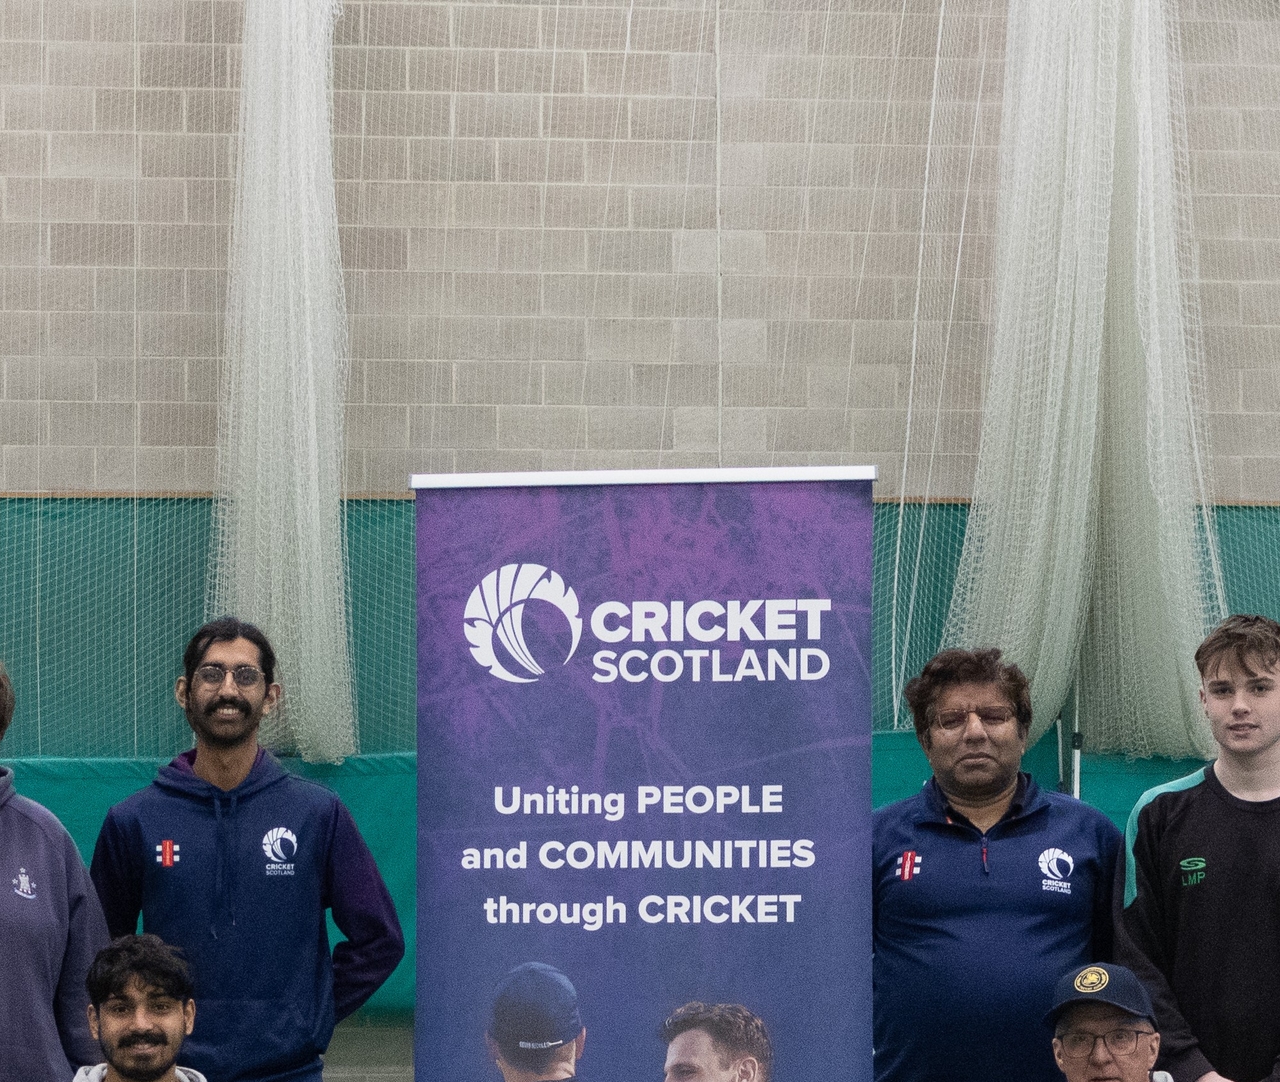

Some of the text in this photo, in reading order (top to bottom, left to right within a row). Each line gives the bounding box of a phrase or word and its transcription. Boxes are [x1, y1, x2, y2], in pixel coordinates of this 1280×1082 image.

[590, 598, 832, 643] CRICKET
[591, 647, 831, 684] SCOTLAND
[493, 784, 784, 822] Uniting PEOPLE
[460, 839, 816, 870] and COMMUNITIES
[1041, 879, 1071, 889] CRICKET
[1042, 884, 1072, 895] SCOTLAND
[1181, 871, 1206, 886] LMP
[483, 894, 802, 931] through CRICKET
